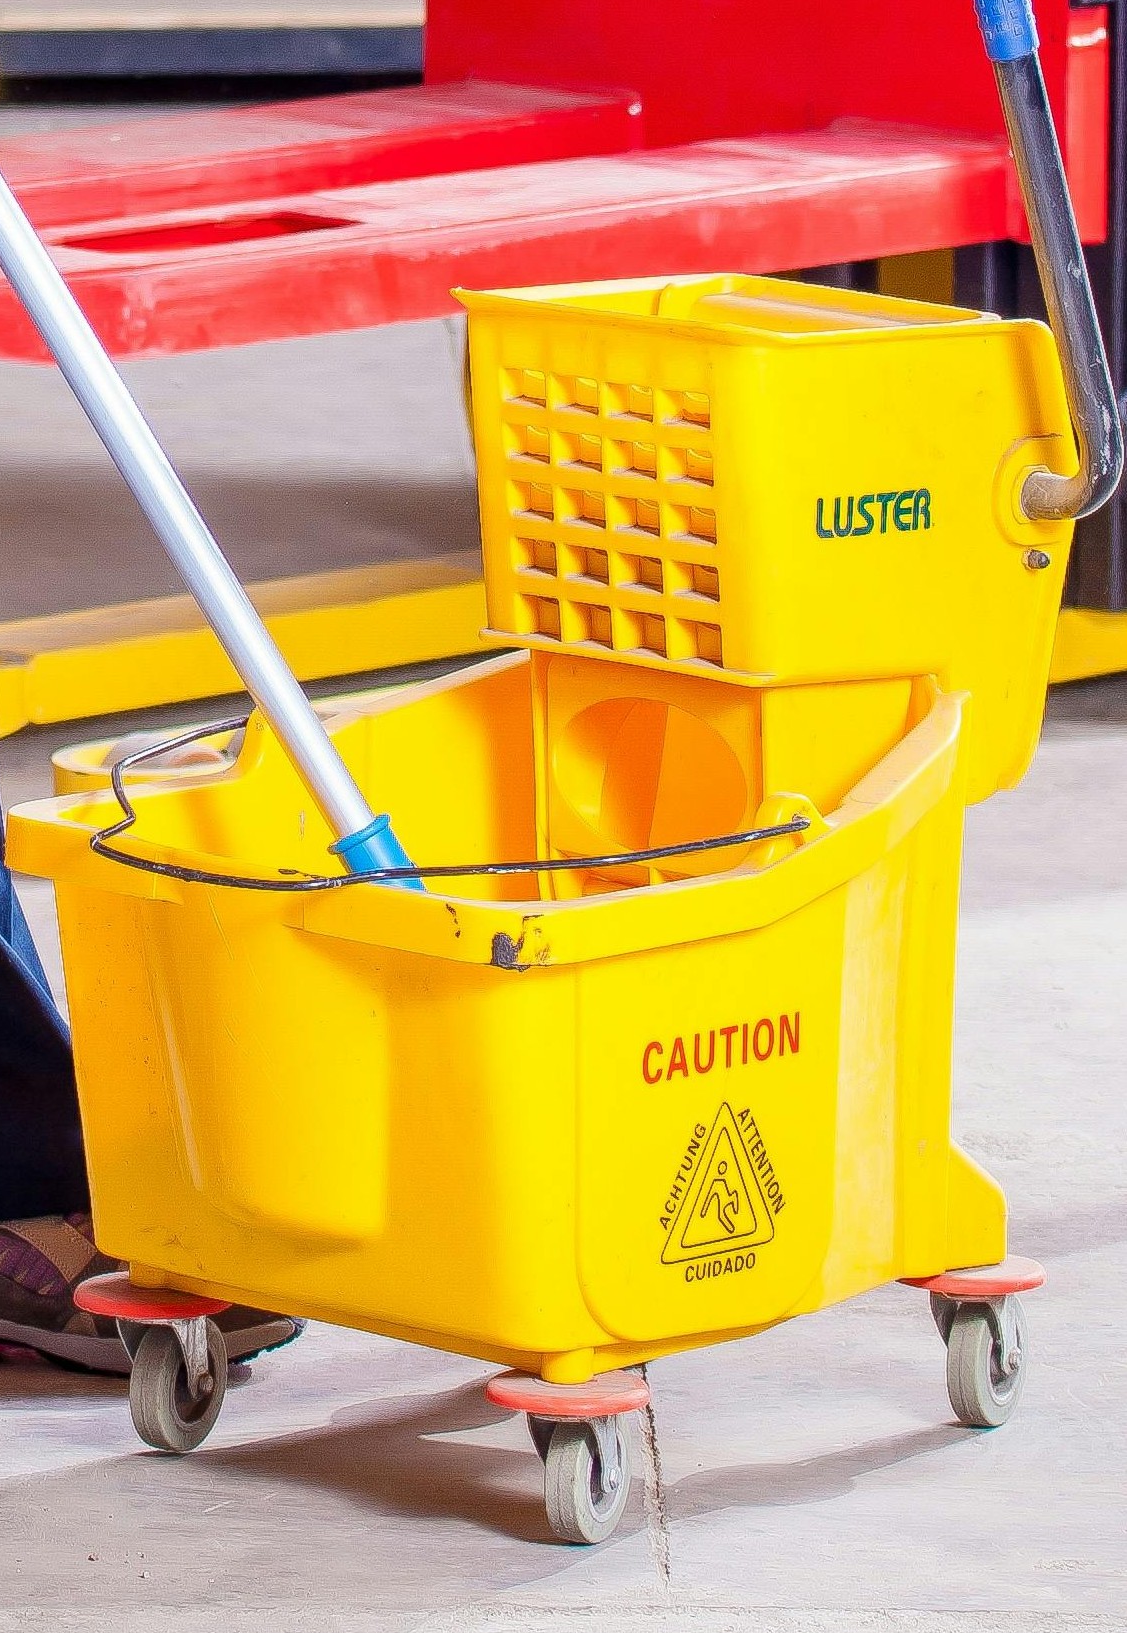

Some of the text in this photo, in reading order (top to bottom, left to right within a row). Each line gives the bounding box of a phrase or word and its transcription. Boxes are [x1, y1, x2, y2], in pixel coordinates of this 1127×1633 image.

[816, 488, 931, 538] LUSTER
[642, 1011, 800, 1085] CAUTION
[658, 1122, 707, 1231] ACHTUNG
[737, 1107, 787, 1216] ATTENTION
[684, 1252, 757, 1283] CUIDADO
